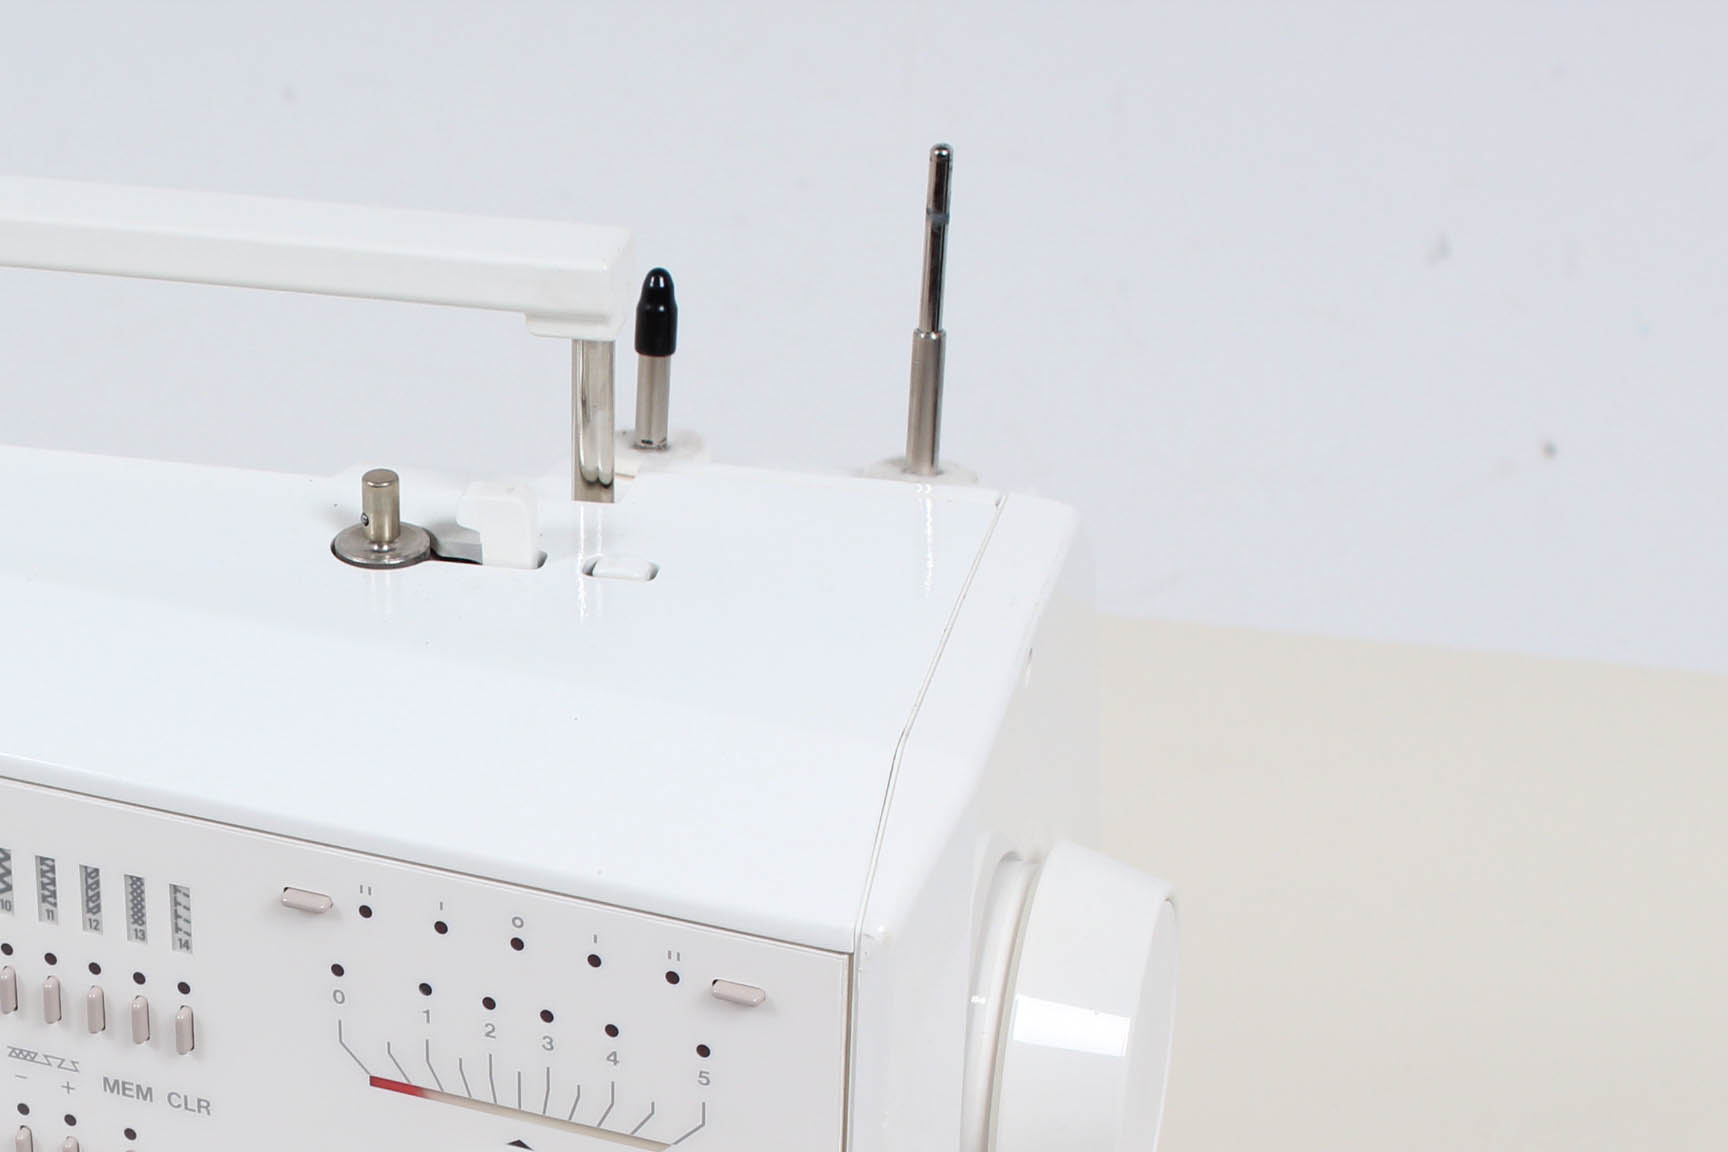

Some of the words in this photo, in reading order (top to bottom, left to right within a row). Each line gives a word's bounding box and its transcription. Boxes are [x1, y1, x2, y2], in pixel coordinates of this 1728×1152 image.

[0, 899, 12, 912] 10
[45, 908, 55, 921] 11
[88, 917, 100, 931] 12
[133, 928, 146, 941] 13
[178, 937, 191, 951] 14
[422, 1008, 431, 1024] 1
[483, 1023, 497, 1040] 2
[542, 1035, 555, 1052] 3
[605, 1050, 620, 1067] 4
[697, 1069, 711, 1087] 5
[102, 1076, 154, 1104] MEM
[166, 1091, 212, 1117] CLR
